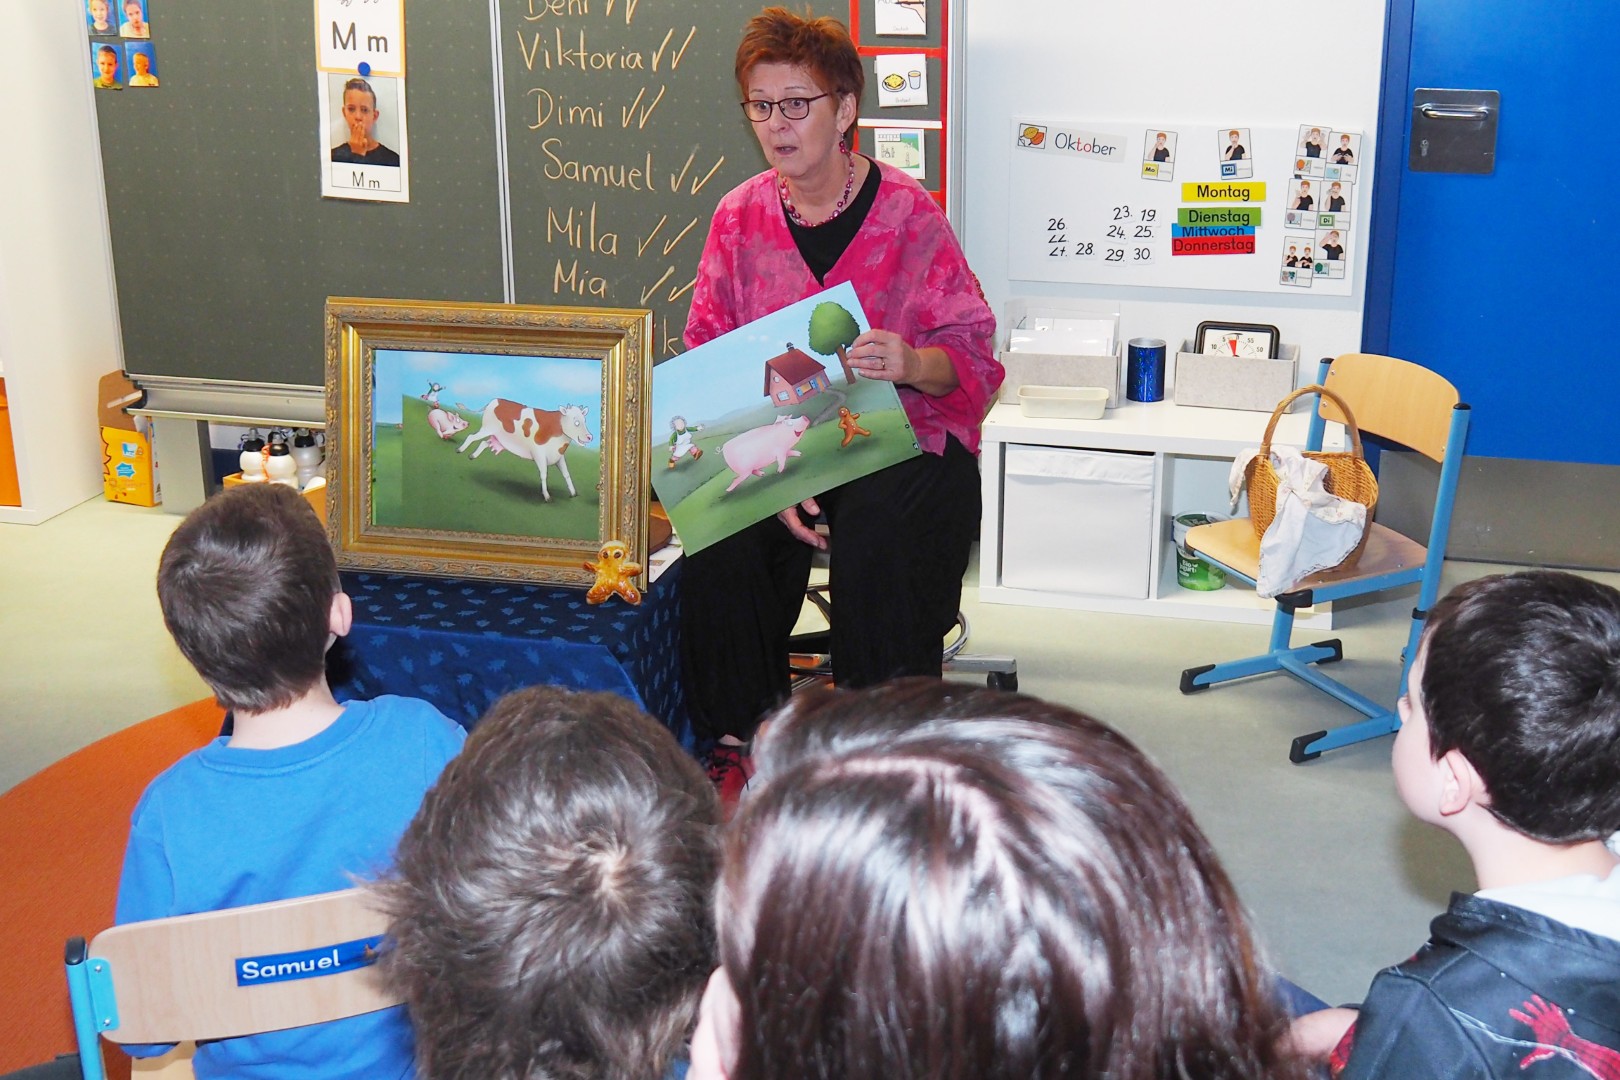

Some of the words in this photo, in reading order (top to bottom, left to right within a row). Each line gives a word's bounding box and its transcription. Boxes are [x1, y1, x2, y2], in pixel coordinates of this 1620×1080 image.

[332, 21, 356, 51] M
[367, 35, 388, 53] m
[517, 26, 644, 71] Viktoria
[527, 87, 604, 129] Dimi
[1054, 132, 1116, 156] Oktober
[352, 170, 364, 188] M
[368, 178, 380, 189] m
[541, 138, 655, 191] Samuel
[1197, 184, 1250, 202] Montag
[547, 201, 618, 256] Mila
[1182, 226, 1245, 237] Mittwoch
[1188, 209, 1250, 226] Dienstag
[1172, 238, 1254, 254] Donnerstag
[553, 259, 607, 299] Mia
[242, 949, 341, 979] Samuel
